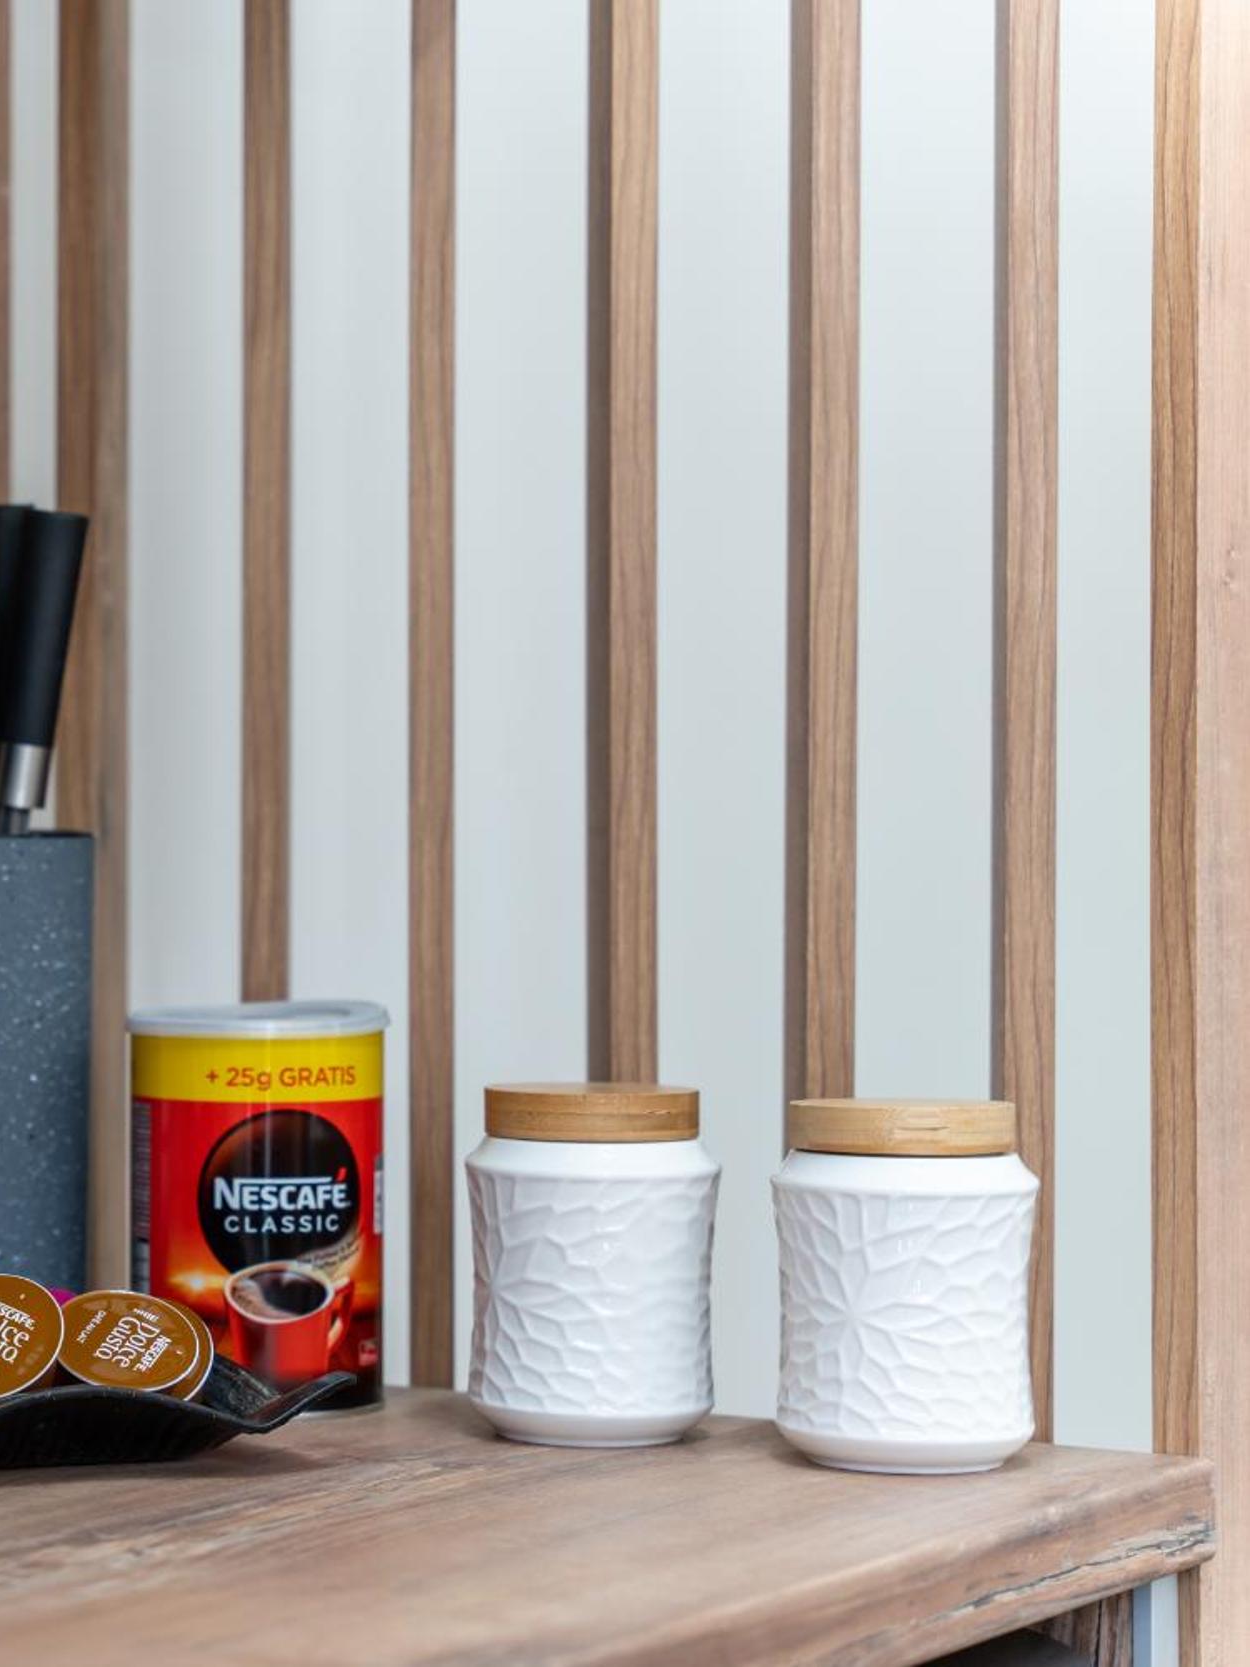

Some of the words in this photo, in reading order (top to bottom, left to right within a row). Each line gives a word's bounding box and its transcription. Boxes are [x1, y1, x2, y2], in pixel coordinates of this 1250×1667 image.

[226, 1067, 271, 1091] 25g
[278, 1066, 356, 1087] GRATIS
[214, 1167, 351, 1210] NESCAFÉ
[224, 1214, 340, 1233] CLASSIC
